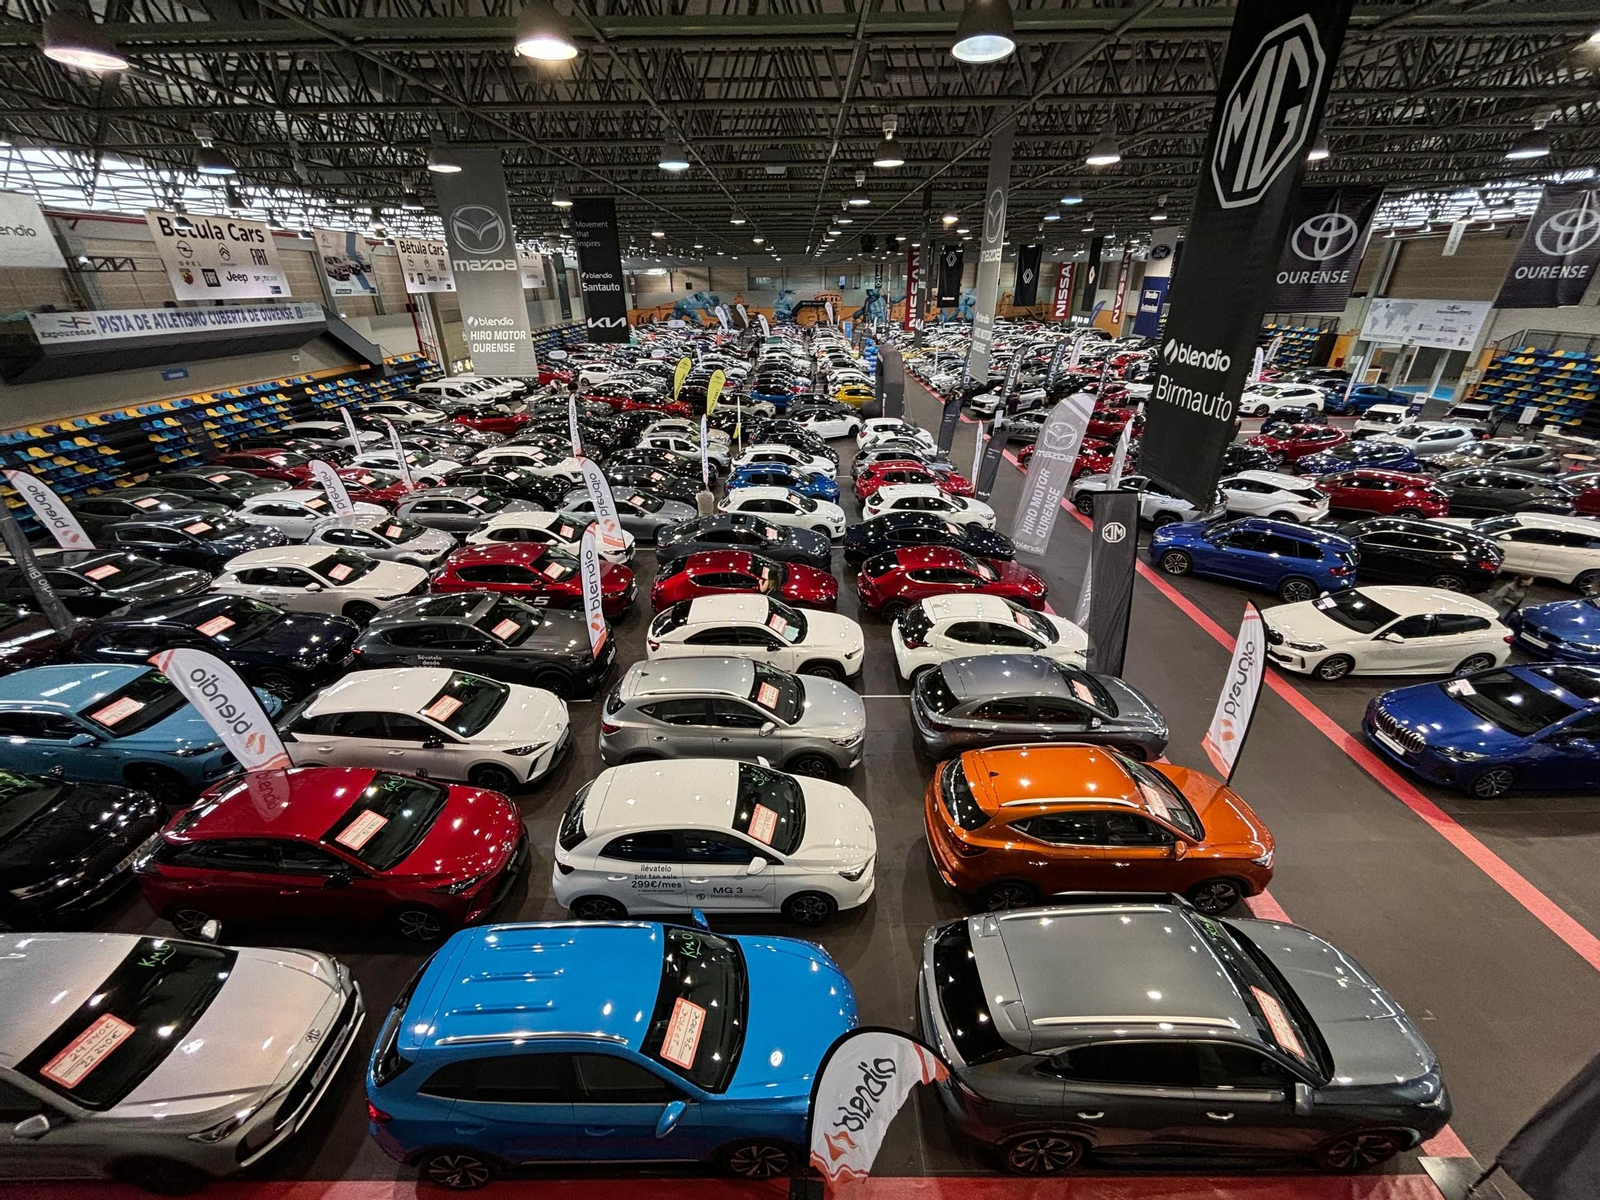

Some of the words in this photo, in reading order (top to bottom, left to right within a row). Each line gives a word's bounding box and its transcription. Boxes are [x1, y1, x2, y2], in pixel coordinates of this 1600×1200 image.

[1219, 35, 1310, 194] MG
[227, 222, 266, 243] Cars
[574, 221, 609, 229] Movement
[576, 230, 590, 238] that
[399, 240, 428, 255] Bétula
[427, 243, 445, 256] Cars
[577, 240, 601, 248] inspires
[250, 248, 269, 266] FIAT
[453, 259, 518, 271] mazda
[1514, 264, 1590, 280] OURENSE
[226, 271, 249, 284] Jeep
[1276, 270, 1349, 285] OURENSE
[582, 282, 621, 292] Santauto
[96, 314, 136, 334] PISTA
[133, 313, 153, 331] DE
[151, 310, 208, 330] ATLETISMO
[207, 308, 249, 326] CUBERTA
[247, 307, 261, 322] DE
[259, 306, 295, 321] OURENSE
[478, 316, 514, 326] blendio
[470, 331, 492, 340] HIRO
[493, 330, 526, 340] MOTOR
[473, 343, 516, 353] OURENSE
[1178, 342, 1231, 372] blendio
[1155, 374, 1232, 422] Birmauto
[1036, 449, 1074, 463] mazda
[1022, 508, 1039, 535] HIRO
[1031, 468, 1051, 508] MOTOR
[1036, 486, 1061, 539] OURENSE
[584, 549, 601, 612] blendio
[640, 864, 672, 873] llévatelo
[631, 880, 682, 889] 299€/mes
[833, 1058, 896, 1131] blendio
